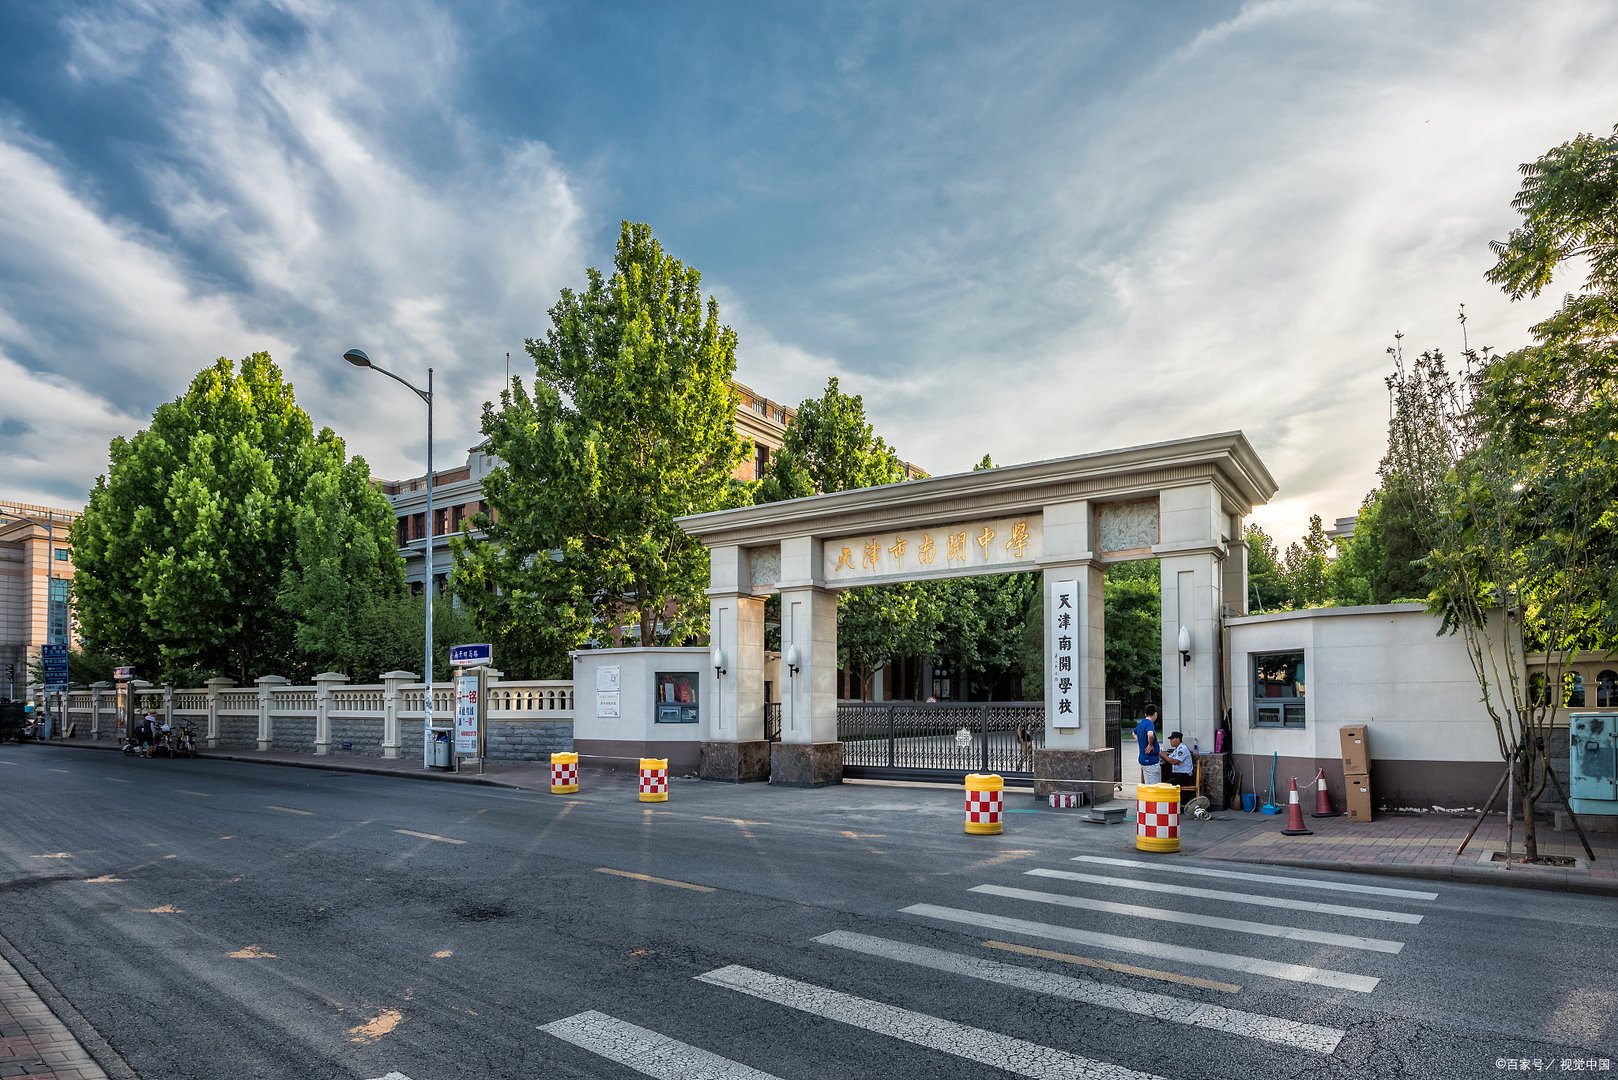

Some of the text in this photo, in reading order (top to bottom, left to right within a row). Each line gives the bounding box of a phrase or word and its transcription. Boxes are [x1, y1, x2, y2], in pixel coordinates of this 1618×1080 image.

[1057, 594, 1073, 715] 天津南開學校
